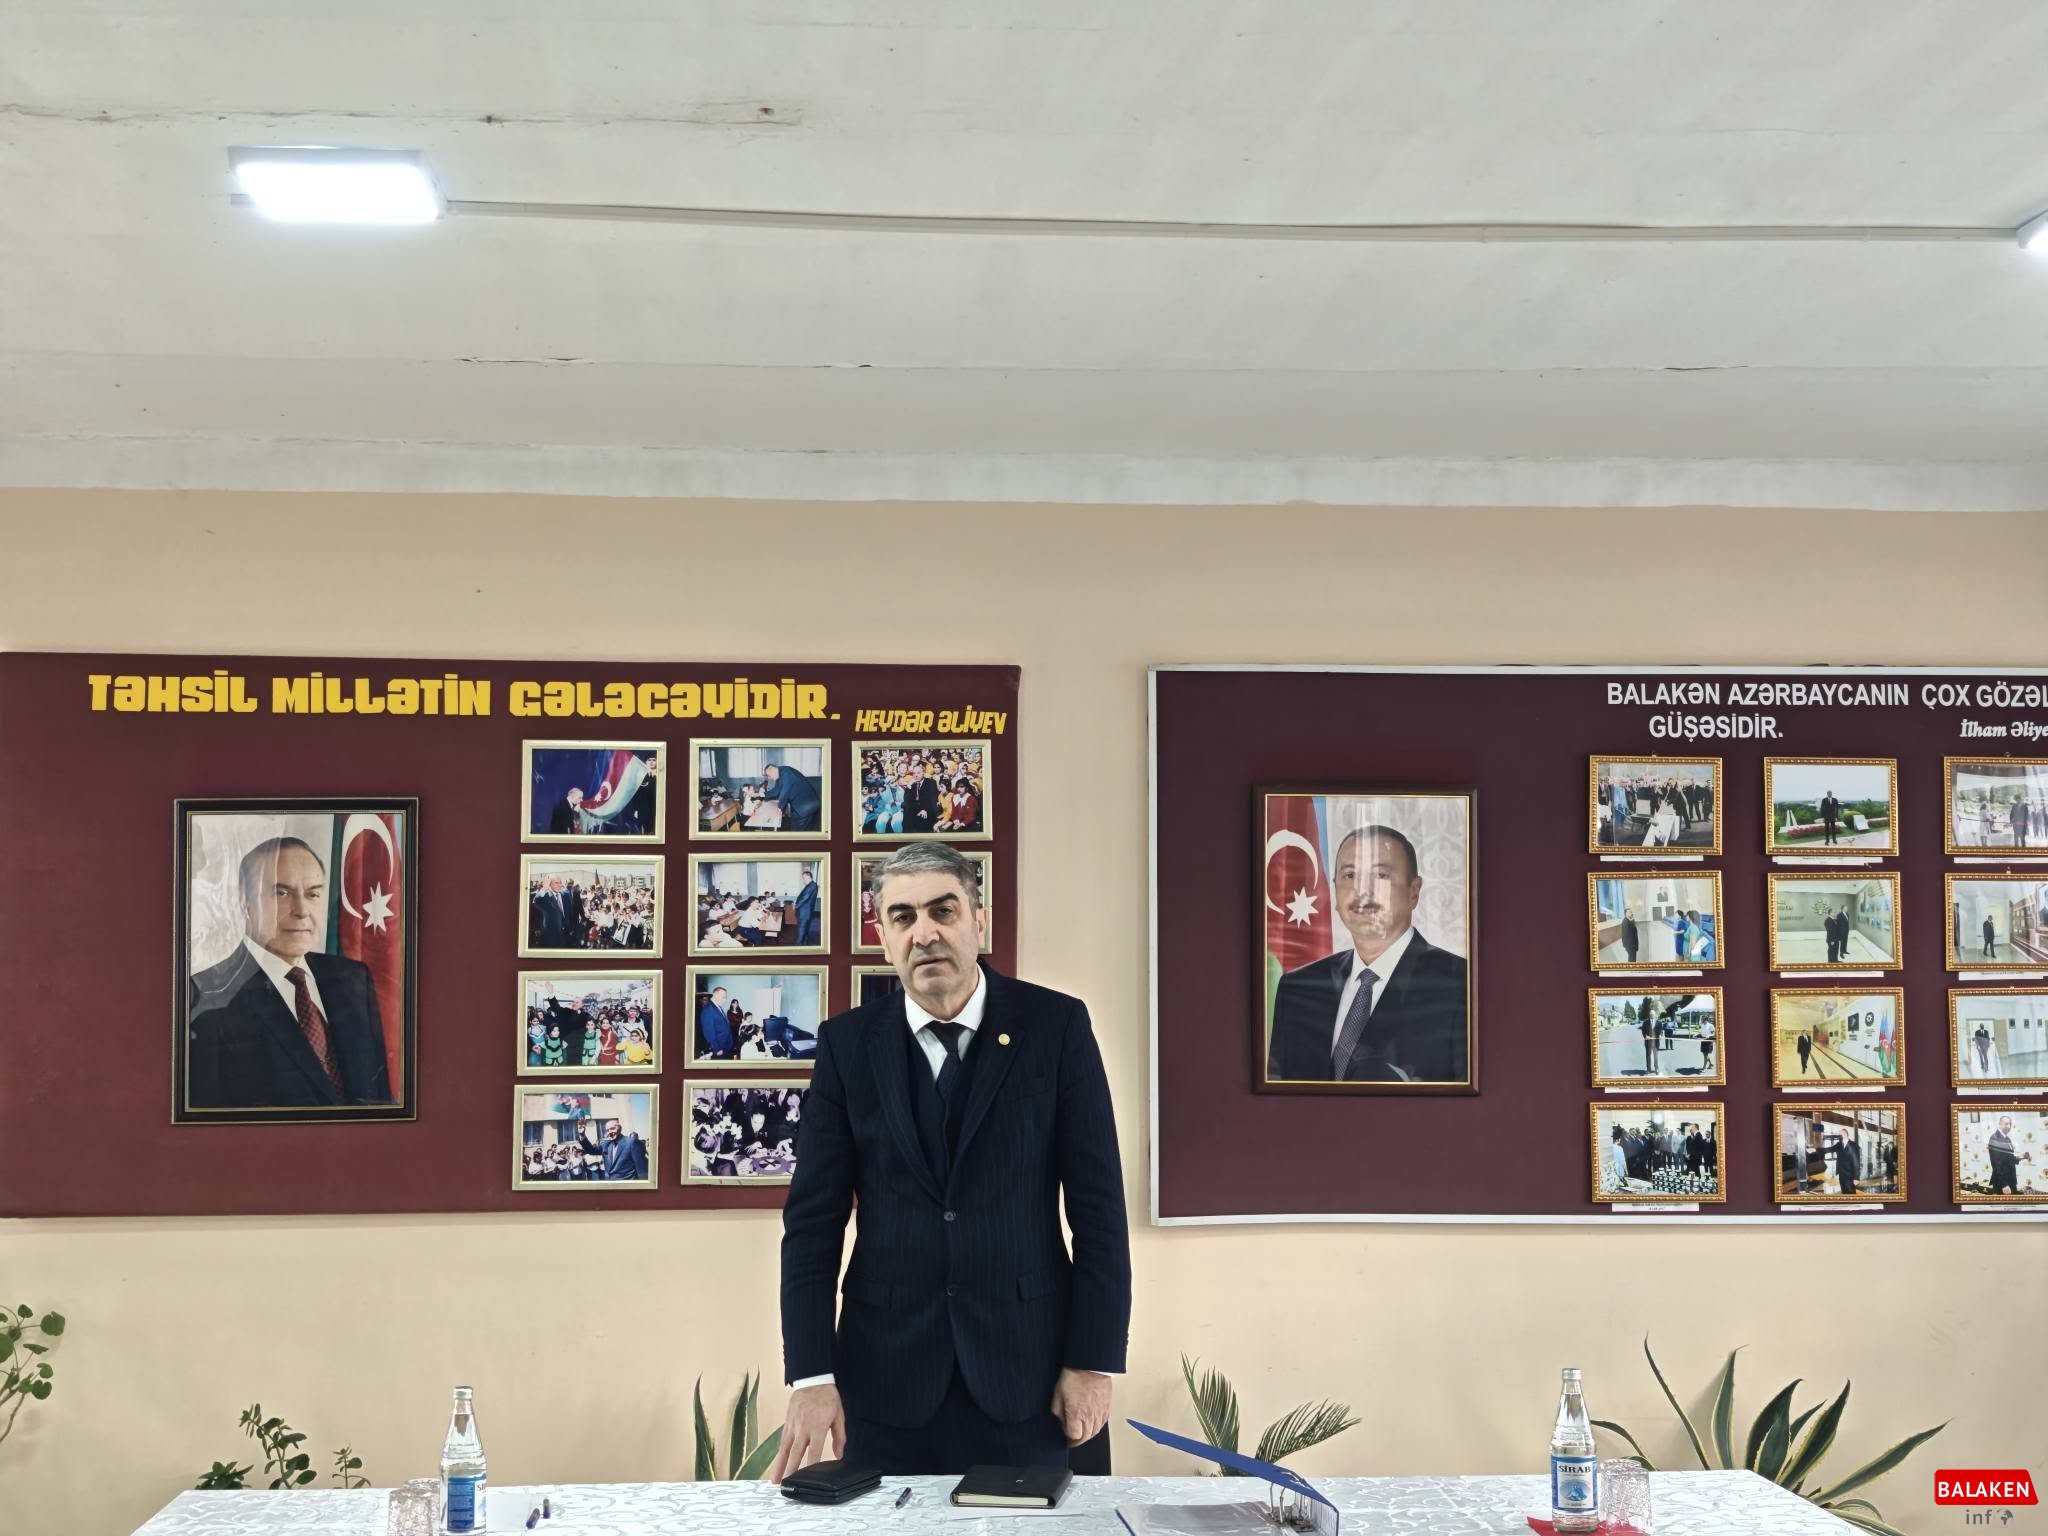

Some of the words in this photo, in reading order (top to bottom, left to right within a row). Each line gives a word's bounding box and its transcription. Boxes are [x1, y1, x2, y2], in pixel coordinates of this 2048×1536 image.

[88, 669, 258, 713] TƏHSİL
[272, 671, 491, 716] MİLLƏTİN
[509, 677, 841, 719] GƏLƏCƏYİDİR.
[1607, 683, 1720, 705] BALAKƏN
[1727, 683, 1909, 706] AZƏRBAYCANIN
[1921, 683, 1971, 710] ÇOX
[855, 709, 935, 733] HEYDƏR
[937, 704, 1008, 735] ƏLİYEV
[1648, 710, 1784, 743] GÜŞƏSİDİR.
[1959, 718, 2008, 738] İlham
[1558, 1464, 1592, 1474] SİRAB
